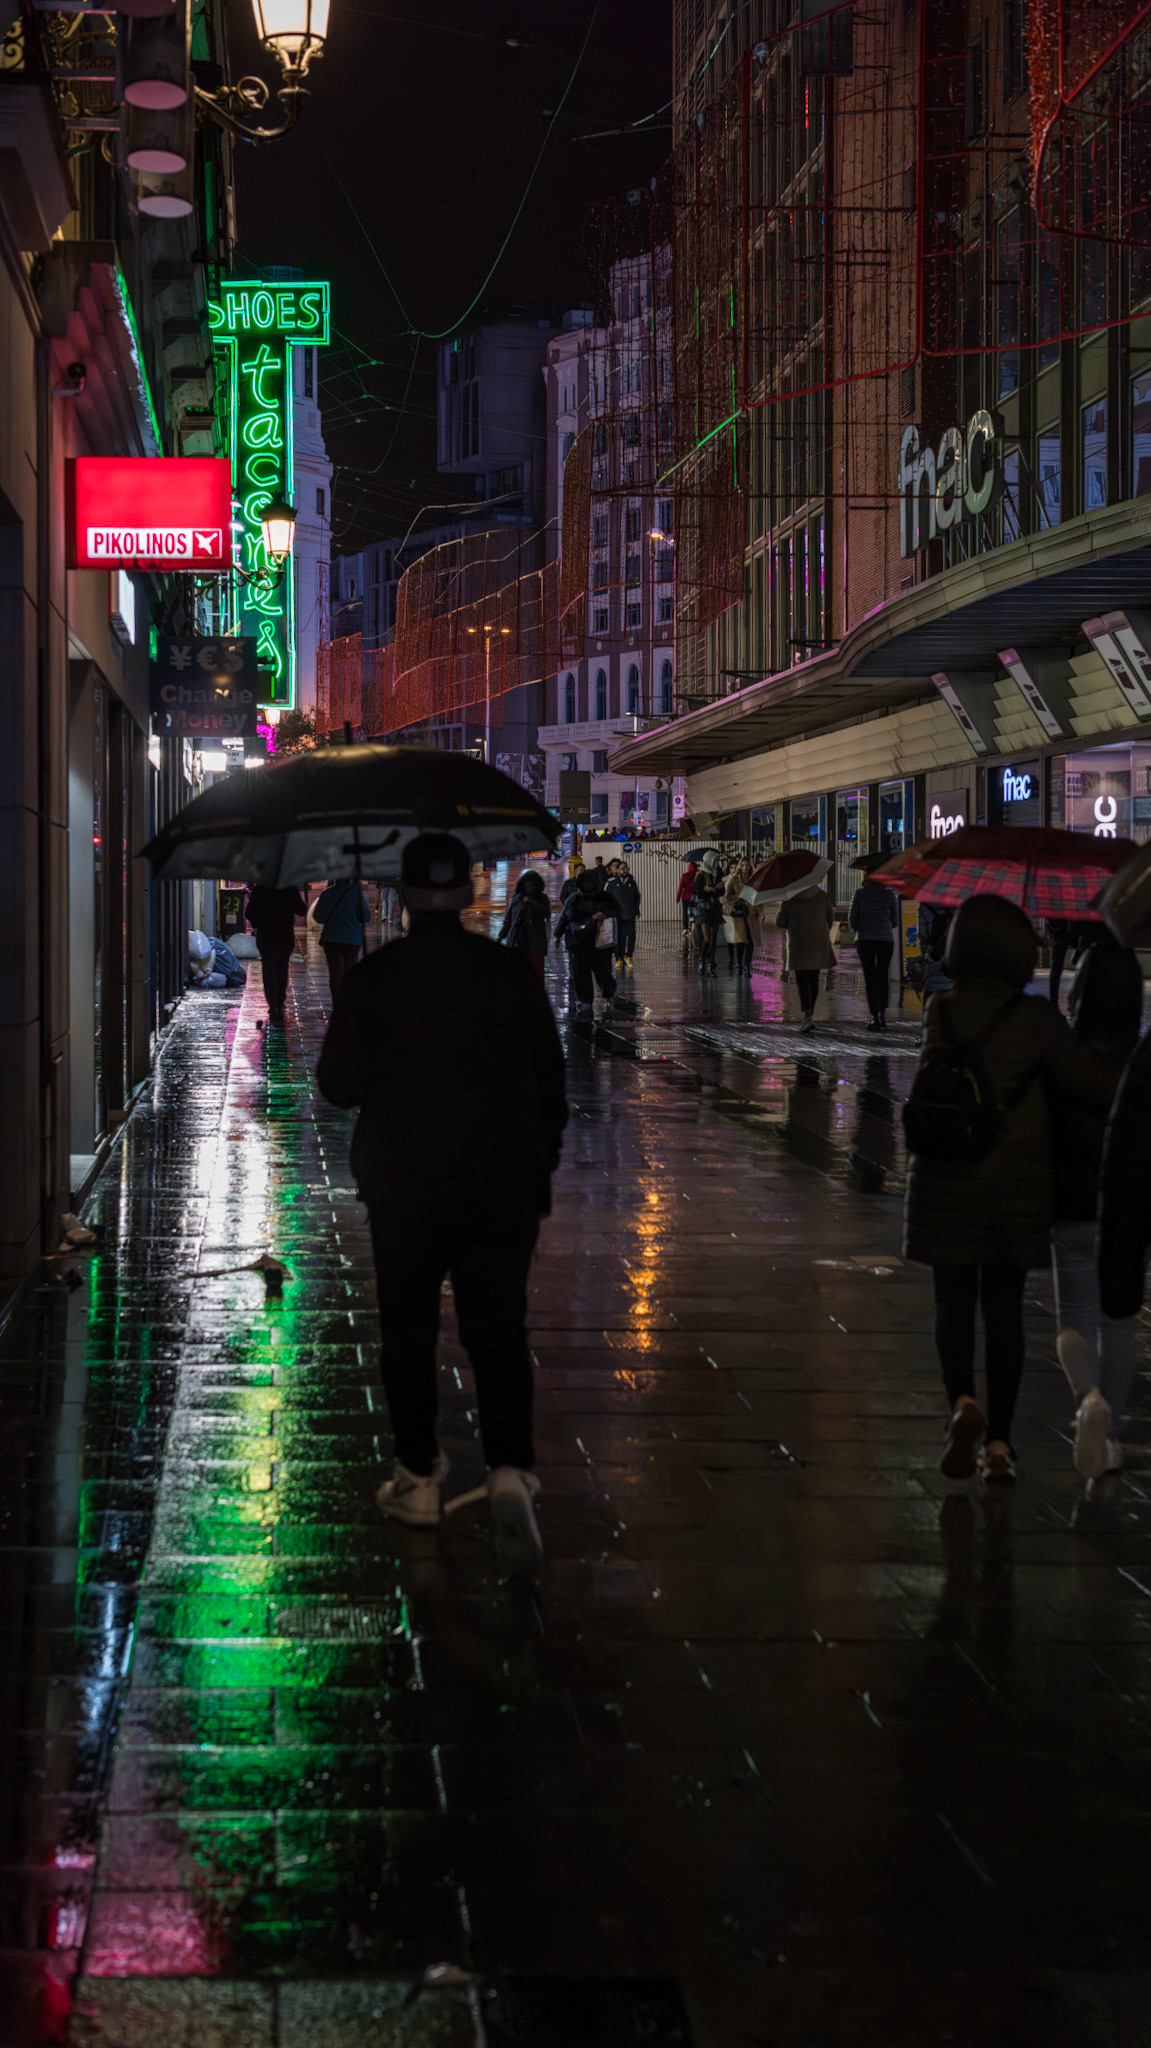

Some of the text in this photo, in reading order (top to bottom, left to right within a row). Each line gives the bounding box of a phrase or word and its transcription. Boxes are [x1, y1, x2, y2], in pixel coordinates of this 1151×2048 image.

[208, 290, 321, 330] SHOES
[897, 409, 995, 559] fnac
[94, 532, 187, 555] PIKOLINOS
[160, 684, 254, 709] Change
[165, 709, 249, 733] Money
[1002, 767, 1032, 802] fnac
